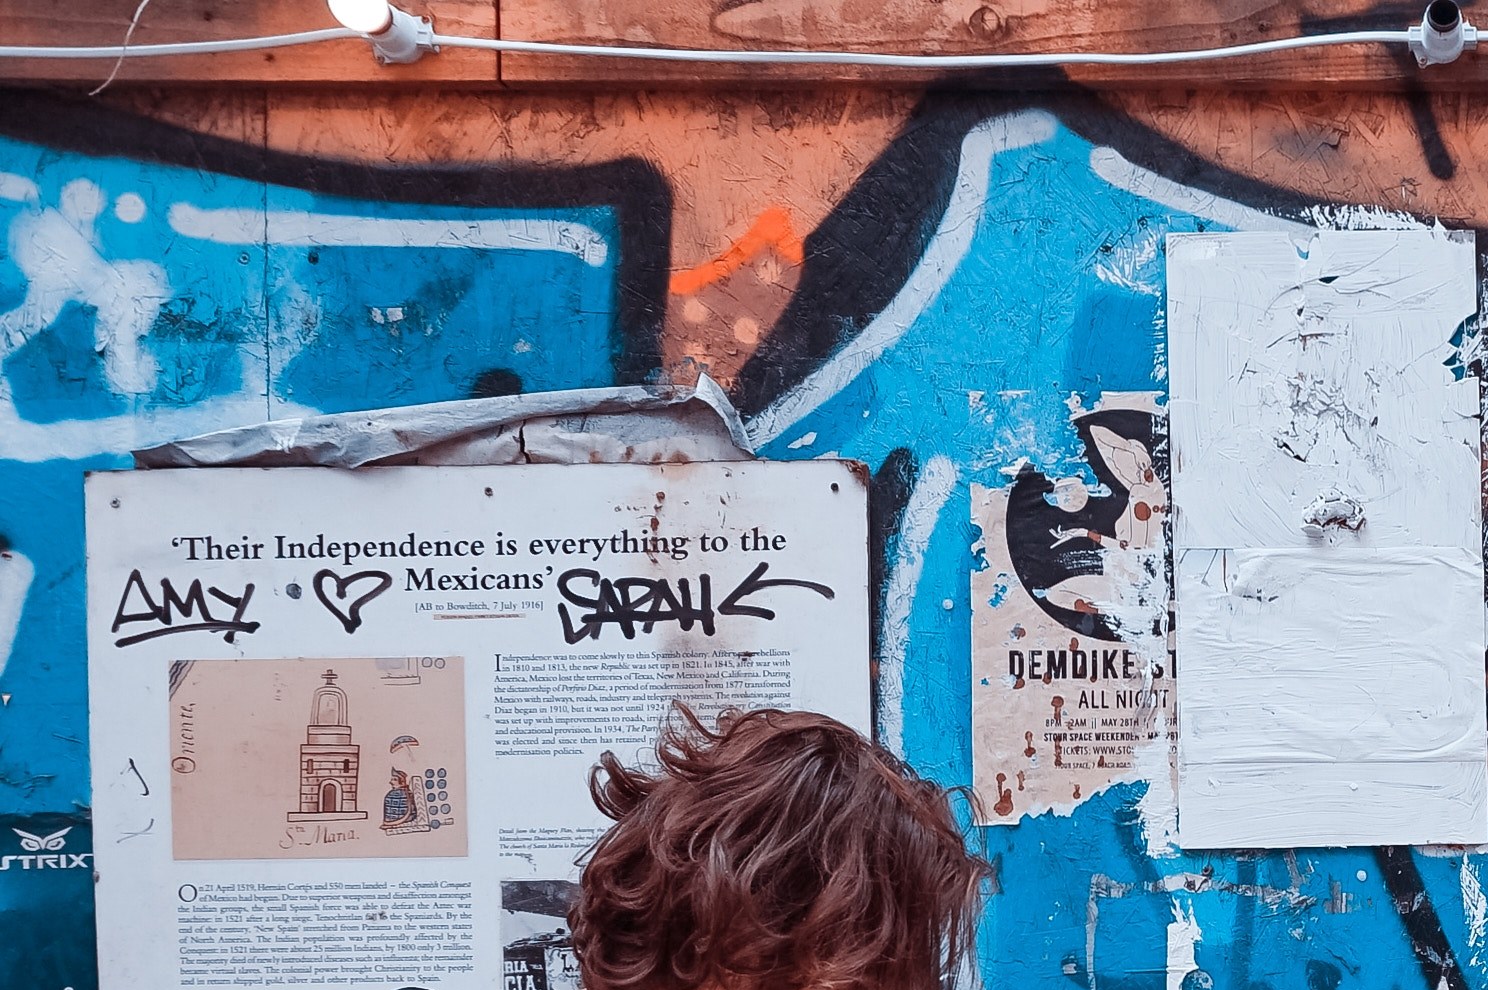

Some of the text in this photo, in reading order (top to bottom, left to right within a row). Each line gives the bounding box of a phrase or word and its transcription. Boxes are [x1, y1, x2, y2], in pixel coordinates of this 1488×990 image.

[274, 532, 485, 566] Independence
[496, 532, 517, 556] is
[529, 529, 688, 561] everything
[700, 532, 728, 553] to
[741, 527, 787, 552] the
[405, 565, 554, 592] Mexicans’
[112, 569, 262, 643] AMY
[435, 603, 444, 611] to
[447, 601, 490, 611] Bowditch,
[493, 601, 498, 610] 7
[500, 601, 518, 612] July
[521, 601, 544, 612] 1916]
[512, 664, 530, 672] 1810
[532, 663, 545, 672] and
[569, 663, 581, 671] the
[601, 662, 630, 671] Republic
[714, 660, 735, 669] 1845,
[772, 659, 790, 667] with
[1078, 690, 1109, 709] ALL
[514, 705, 537, 715] began
[550, 705, 569, 714] 1910,
[571, 704, 584, 713] but
[594, 705, 609, 713] was
[626, 704, 644, 712] until
[647, 703, 665, 711] 1924
[1045, 718, 1061, 728] 8PM
[1101, 718, 1117, 727] MAY
[1119, 718, 1139, 727] 28TH
[1069, 732, 1093, 742] SPACE
[1095, 732, 1140, 742] WEEKENDER
